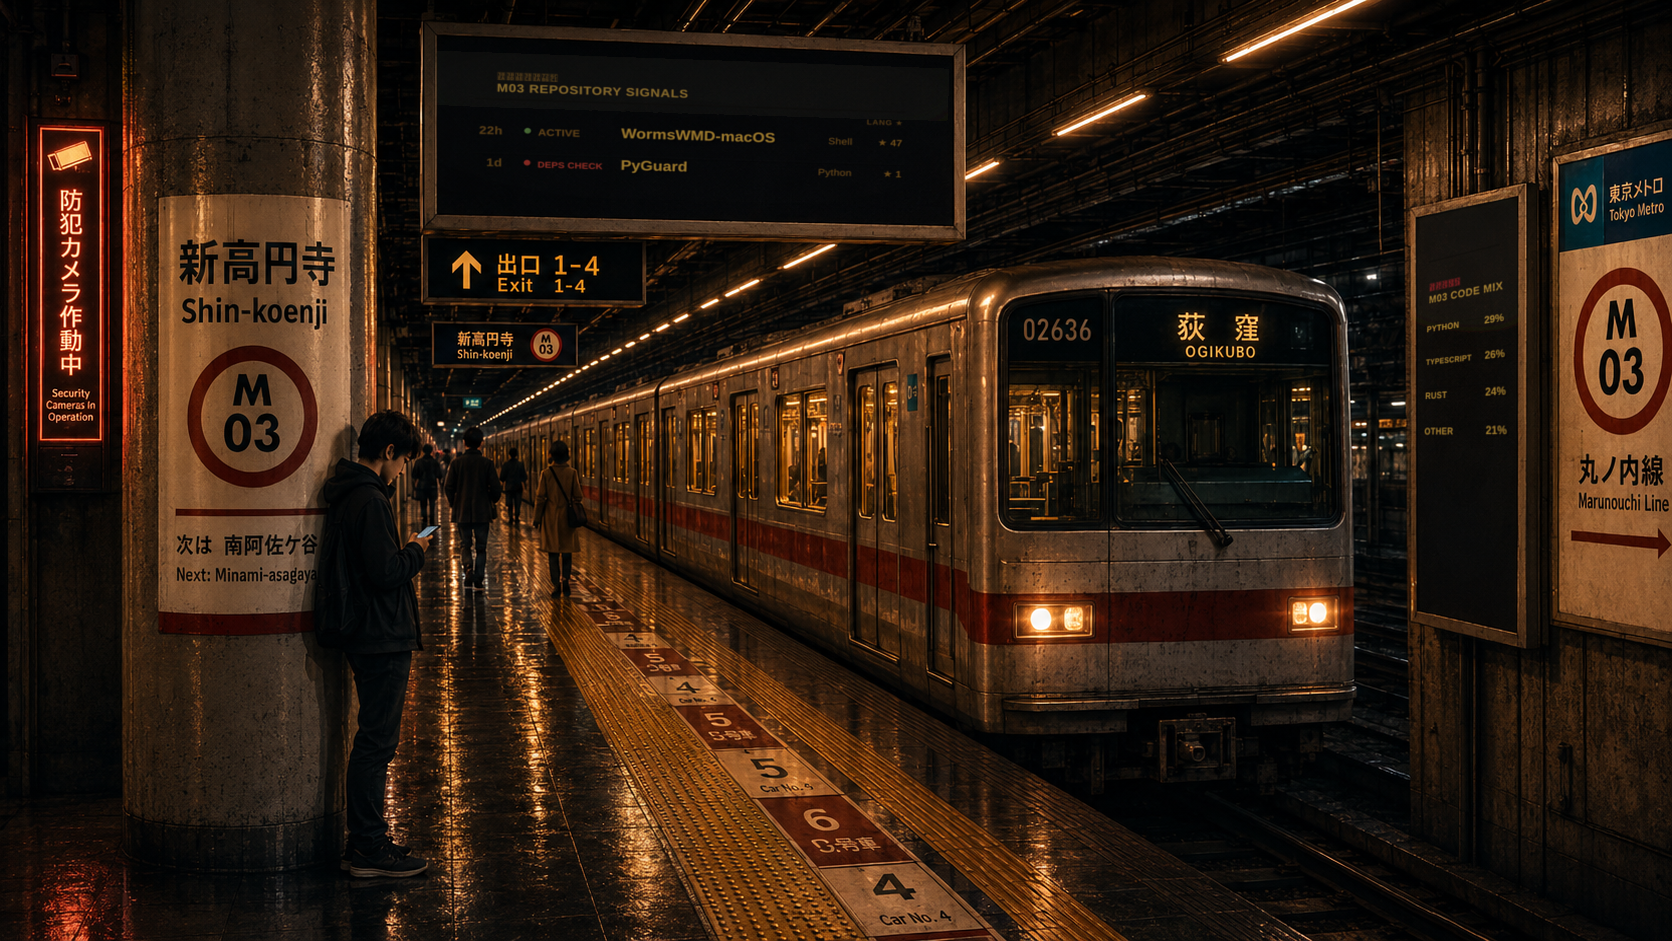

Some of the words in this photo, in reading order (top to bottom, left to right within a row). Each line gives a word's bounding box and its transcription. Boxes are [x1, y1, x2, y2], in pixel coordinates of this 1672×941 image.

[497, 83, 525, 94] M03
[529, 84, 622, 97] REPOSITORY
[626, 87, 689, 99] SIGNALS
[866, 118, 893, 127] LANG
[479, 125, 503, 136] 22h
[538, 128, 581, 138] ACTIVE
[621, 127, 776, 144] WormsWMD-macOS
[828, 137, 853, 147] Shell
[889, 139, 903, 147] 47
[486, 157, 502, 168] 1d
[537, 160, 565, 169] DEPS
[567, 161, 603, 171] CHECK
[621, 159, 688, 174] PyGuard
[818, 168, 852, 179] Python
[895, 170, 902, 179] 1
[1609, 177, 1663, 204] 東京メトロ
[1609, 207, 1635, 223] Tokyo
[1637, 202, 1665, 217] Metro
[180, 239, 335, 286] 新高円寺
[497, 253, 540, 276] 出口
[554, 254, 600, 276] 1-4
[60, 189, 83, 376] 防犯カメラ作動中
[497, 277, 534, 293] Exit
[554, 278, 586, 294] 1-4
[1428, 292, 1448, 304] M03
[1450, 285, 1480, 300] CODE
[1483, 281, 1503, 294] MIX
[181, 297, 327, 330] Shin-koenji
[1426, 321, 1460, 333] PYTHON
[1484, 313, 1505, 325] 29%
[1606, 298, 1637, 340] M
[457, 331, 514, 348] 新高円寺
[541, 334, 551, 343] M
[1023, 318, 1092, 341] 02636
[457, 349, 513, 362] Shin-koenji
[539, 344, 554, 355] 03
[1185, 345, 1256, 358] OGIKUBO
[1425, 353, 1473, 366] TYPESCRIPT
[1484, 349, 1506, 360] 26%
[1599, 347, 1644, 395] 03
[52, 388, 91, 400] Security
[233, 374, 272, 406] M
[1425, 390, 1448, 400] RUST
[1484, 385, 1507, 397] 24%
[46, 400, 85, 410] Cameras
[48, 412, 94, 424] Operation
[224, 413, 280, 452] 03
[1424, 426, 1454, 436] OTHER
[1485, 424, 1508, 436] 21%
[1579, 453, 1664, 486] 丸ノ内線
[1578, 492, 1641, 511] Marunouchi
[1645, 494, 1670, 512] Line
[176, 534, 212, 555] 次は
[176, 567, 211, 582] Next:
[215, 567, 318, 585] Minami-asagaya
[644, 653, 665, 663] 5
[676, 681, 700, 694] 4
[704, 712, 732, 727] 5
[750, 758, 788, 778] 5
[760, 785, 780, 793] Car
[803, 808, 840, 831] 6
[873, 873, 917, 900] 4
[879, 914, 907, 926] Car
[907, 911, 938, 924] No.
[940, 910, 952, 922] 4
